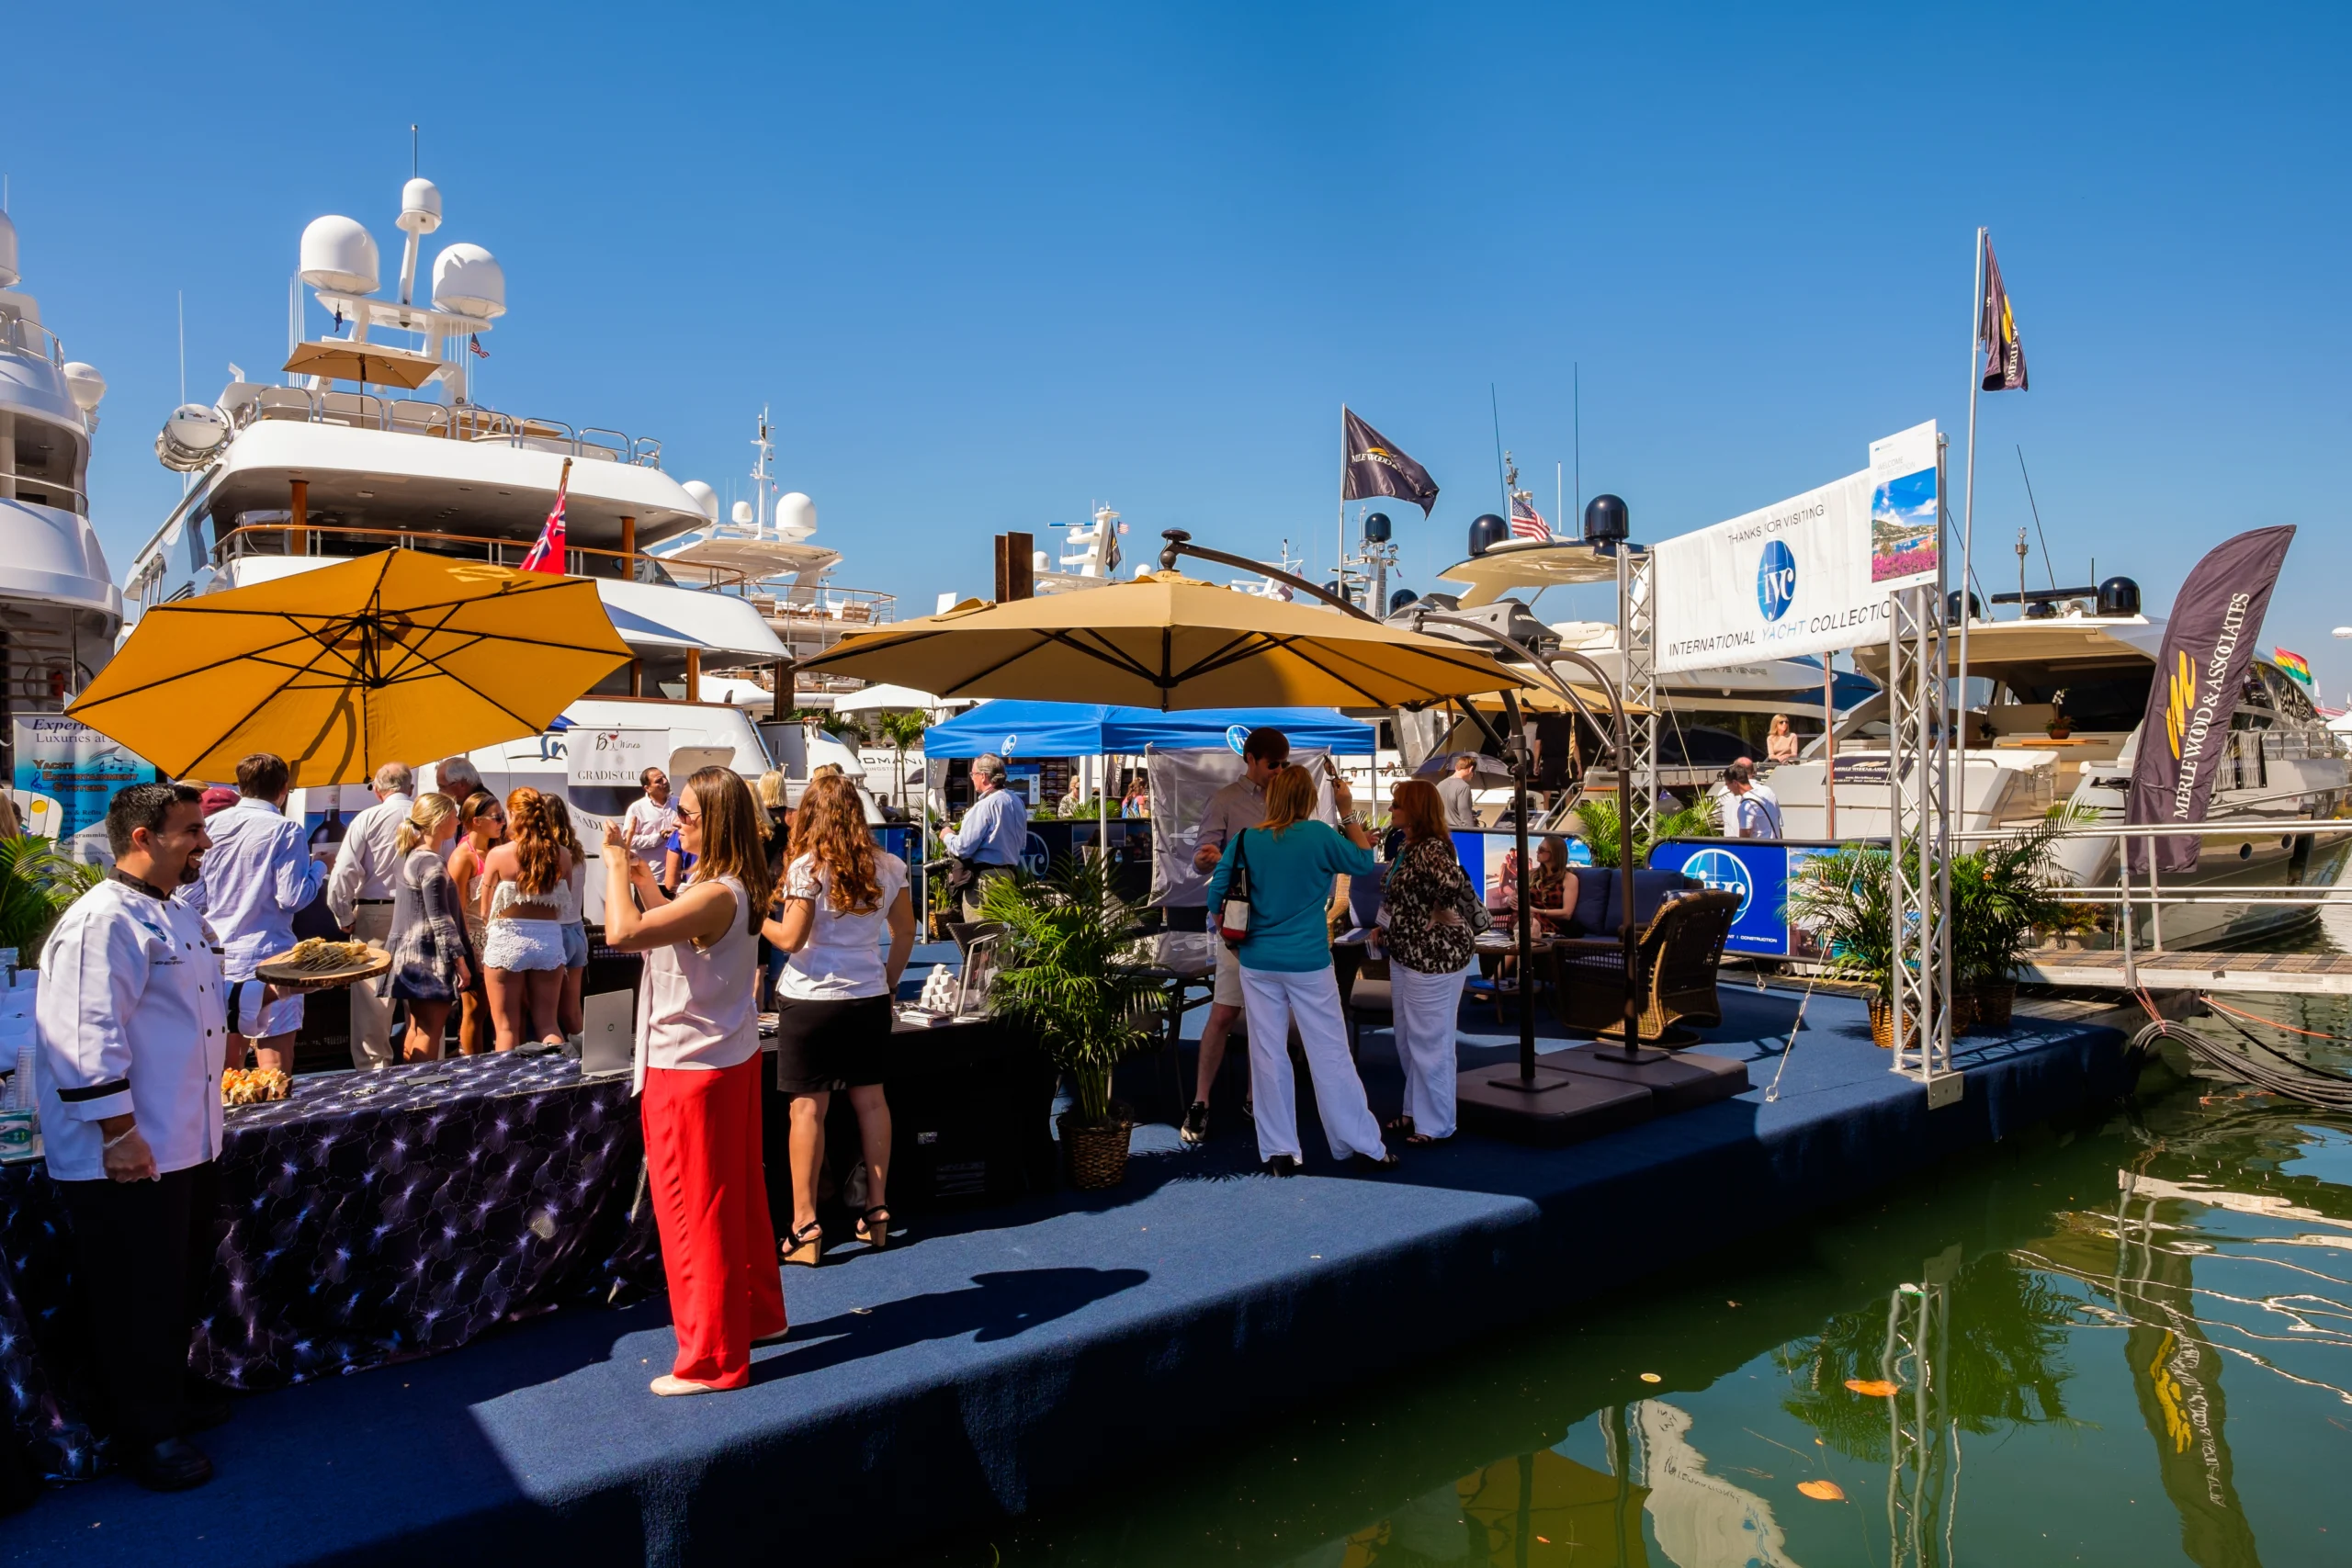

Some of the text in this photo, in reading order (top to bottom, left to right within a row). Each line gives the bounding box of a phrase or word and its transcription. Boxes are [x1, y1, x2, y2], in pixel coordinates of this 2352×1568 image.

[1367, 453, 1392, 466] WOOD
[1877, 456, 1904, 470] WELCOME
[1727, 525, 1762, 545] THANKS
[1783, 504, 1825, 527] VISITING
[1668, 600, 1891, 658] INTERNATIONAL YACHT COLLECTIO
[2173, 592, 2250, 819] MERLE WOOD & ASSOCIATES
[36, 732, 91, 743] Luxuries
[95, 734, 106, 743] at
[619, 739, 641, 749] Wines
[32, 759, 75, 770] YACHT
[856, 757, 922, 765] OMANI
[41, 771, 139, 781] ENTERTAINMENT
[577, 770, 641, 781] GRADIS'CIU
[52, 782, 108, 792] SYSTEMS
